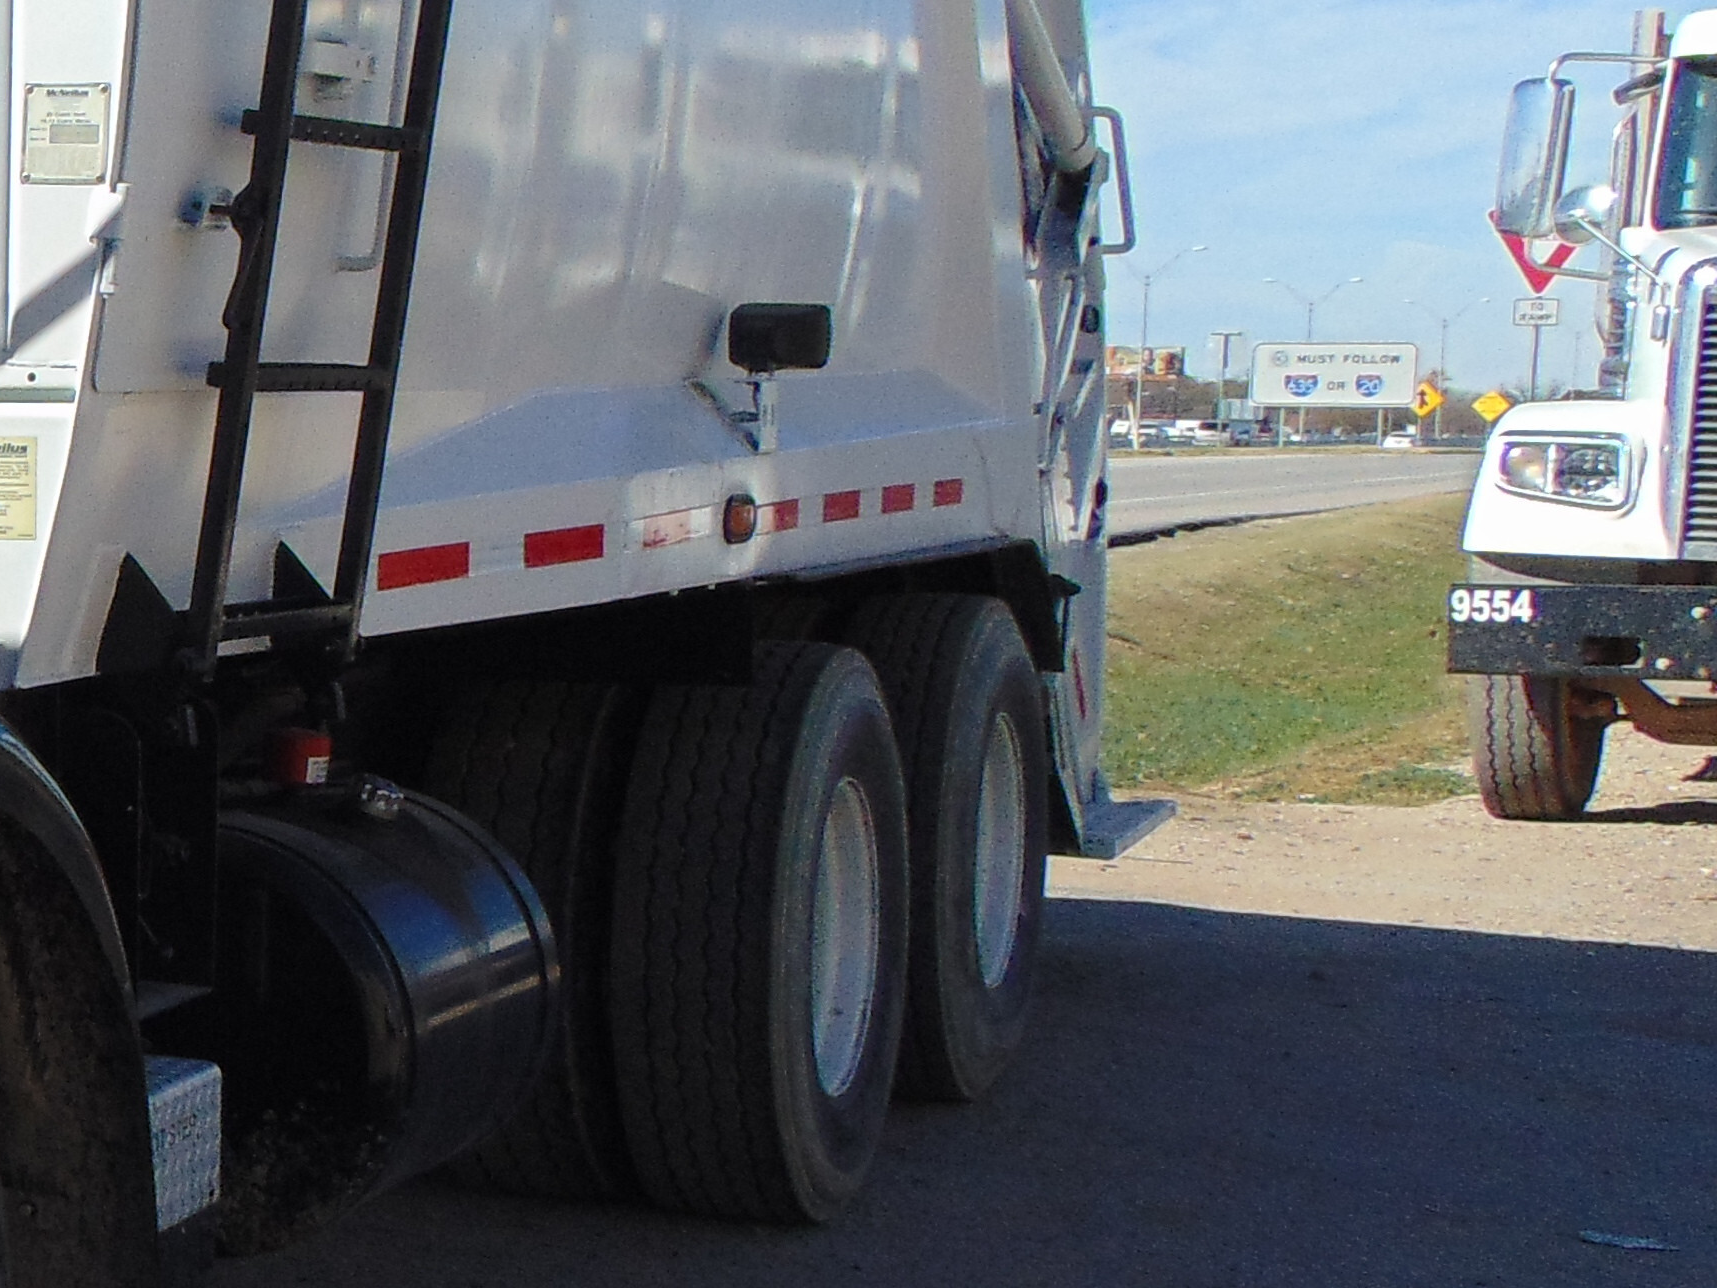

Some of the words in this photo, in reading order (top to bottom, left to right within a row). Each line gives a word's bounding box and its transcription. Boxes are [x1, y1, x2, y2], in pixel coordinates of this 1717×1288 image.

[1296, 354, 1335, 364] MUST
[1342, 354, 1401, 364] FOLLOW
[1326, 381, 1346, 391] OR
[1360, 380, 1380, 393] 20
[1451, 589, 1533, 623] 9554
